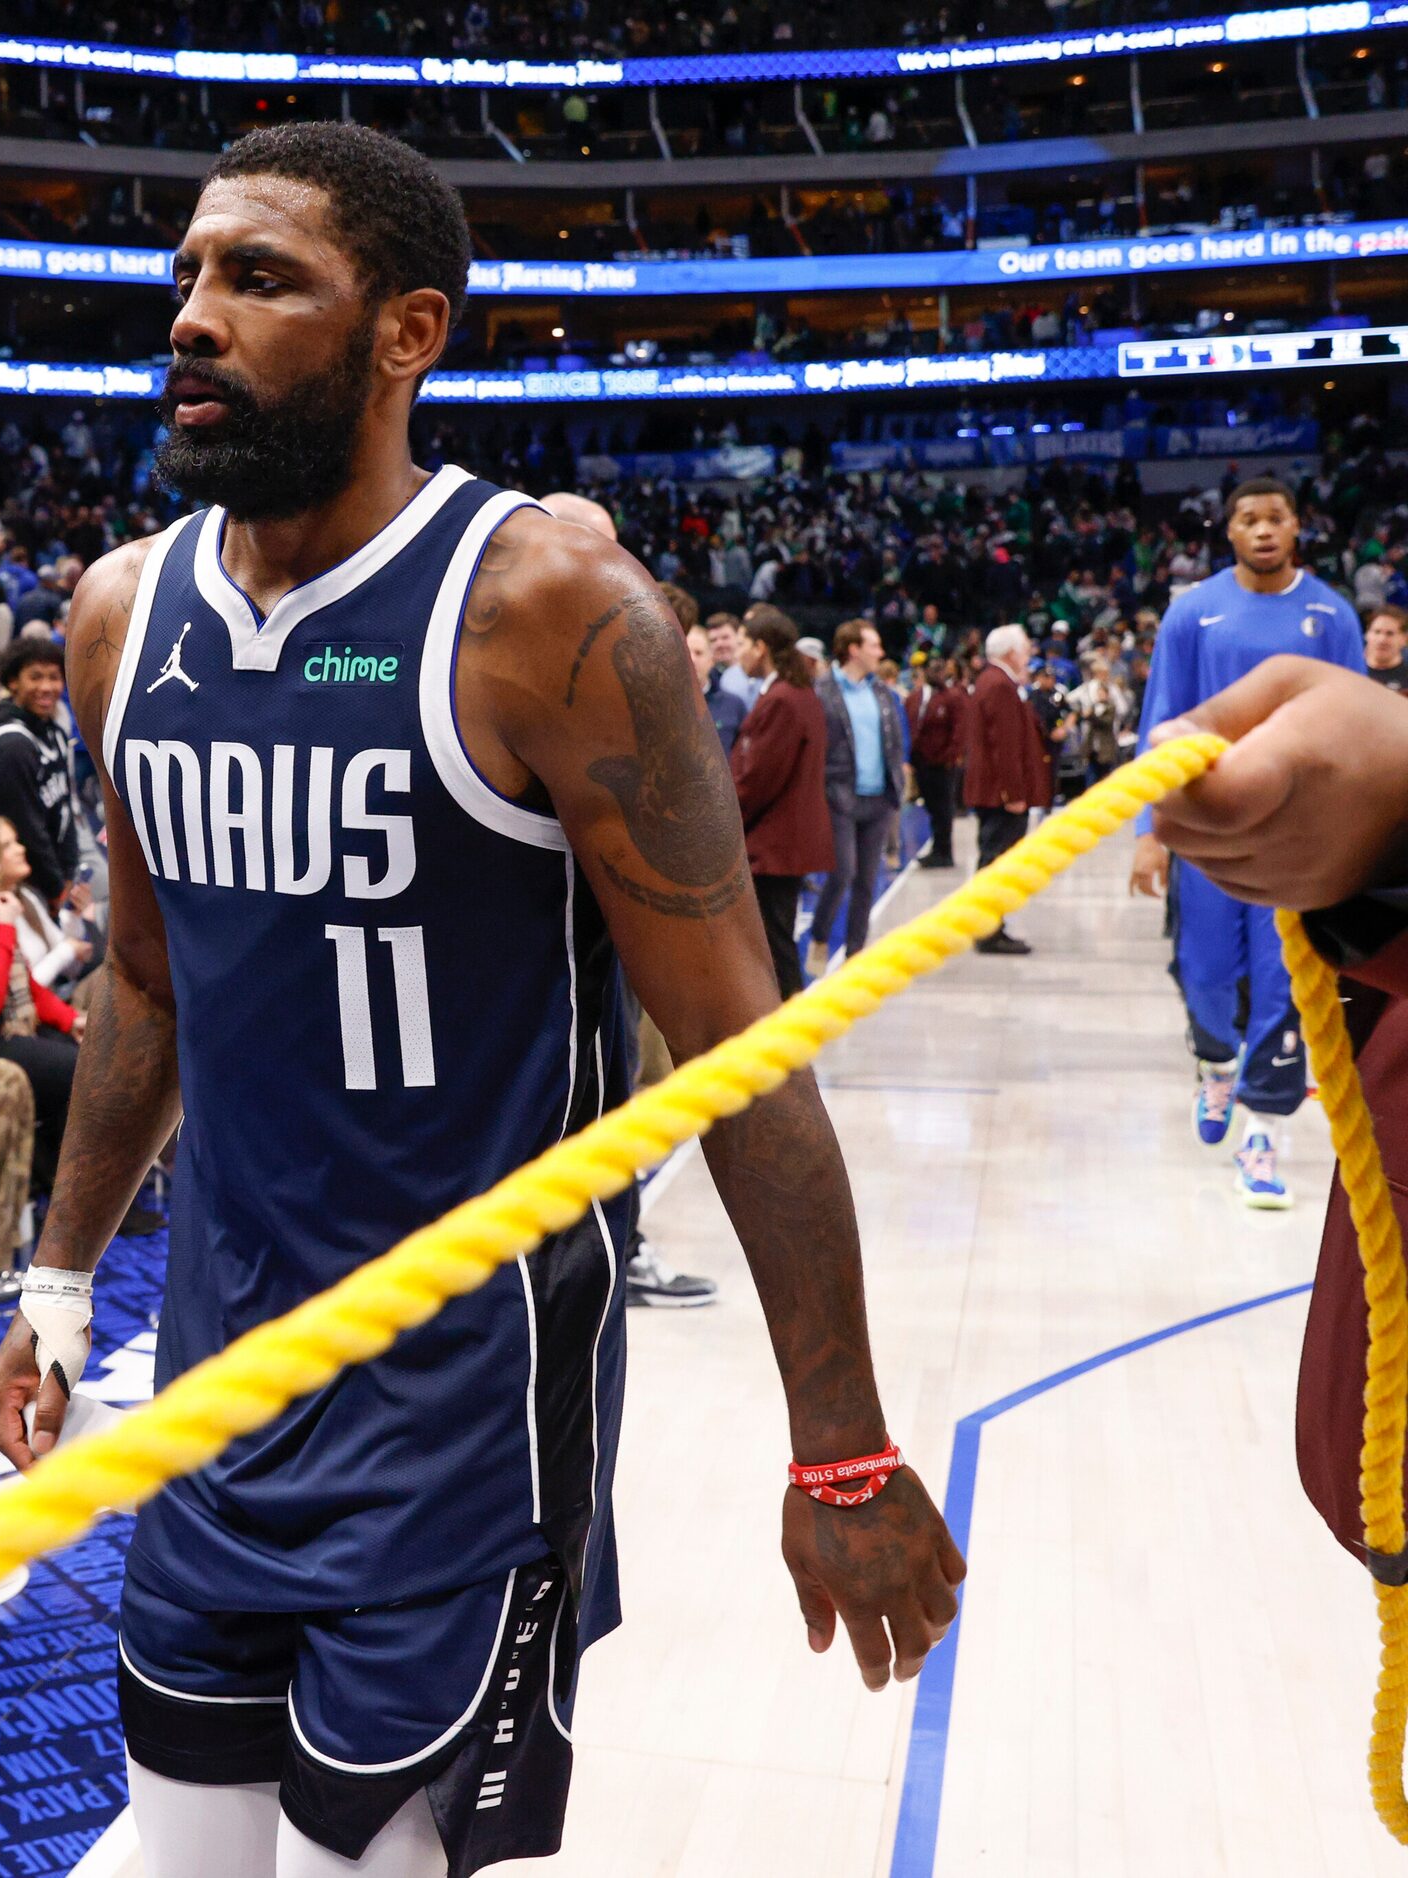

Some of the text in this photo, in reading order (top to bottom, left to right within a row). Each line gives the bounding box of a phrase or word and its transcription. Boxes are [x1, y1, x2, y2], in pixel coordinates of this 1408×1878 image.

[46, 249, 106, 275] goes
[110, 249, 165, 277] hard
[998, 225, 1408, 274] Our team goes hard in the pai
[303, 646, 399, 682] chime
[324, 923, 436, 1091] 11
[802, 1468, 834, 1484] 5106
[0, 1777, 113, 1826] PACK
[2, 1825, 107, 1876] ARLIE
